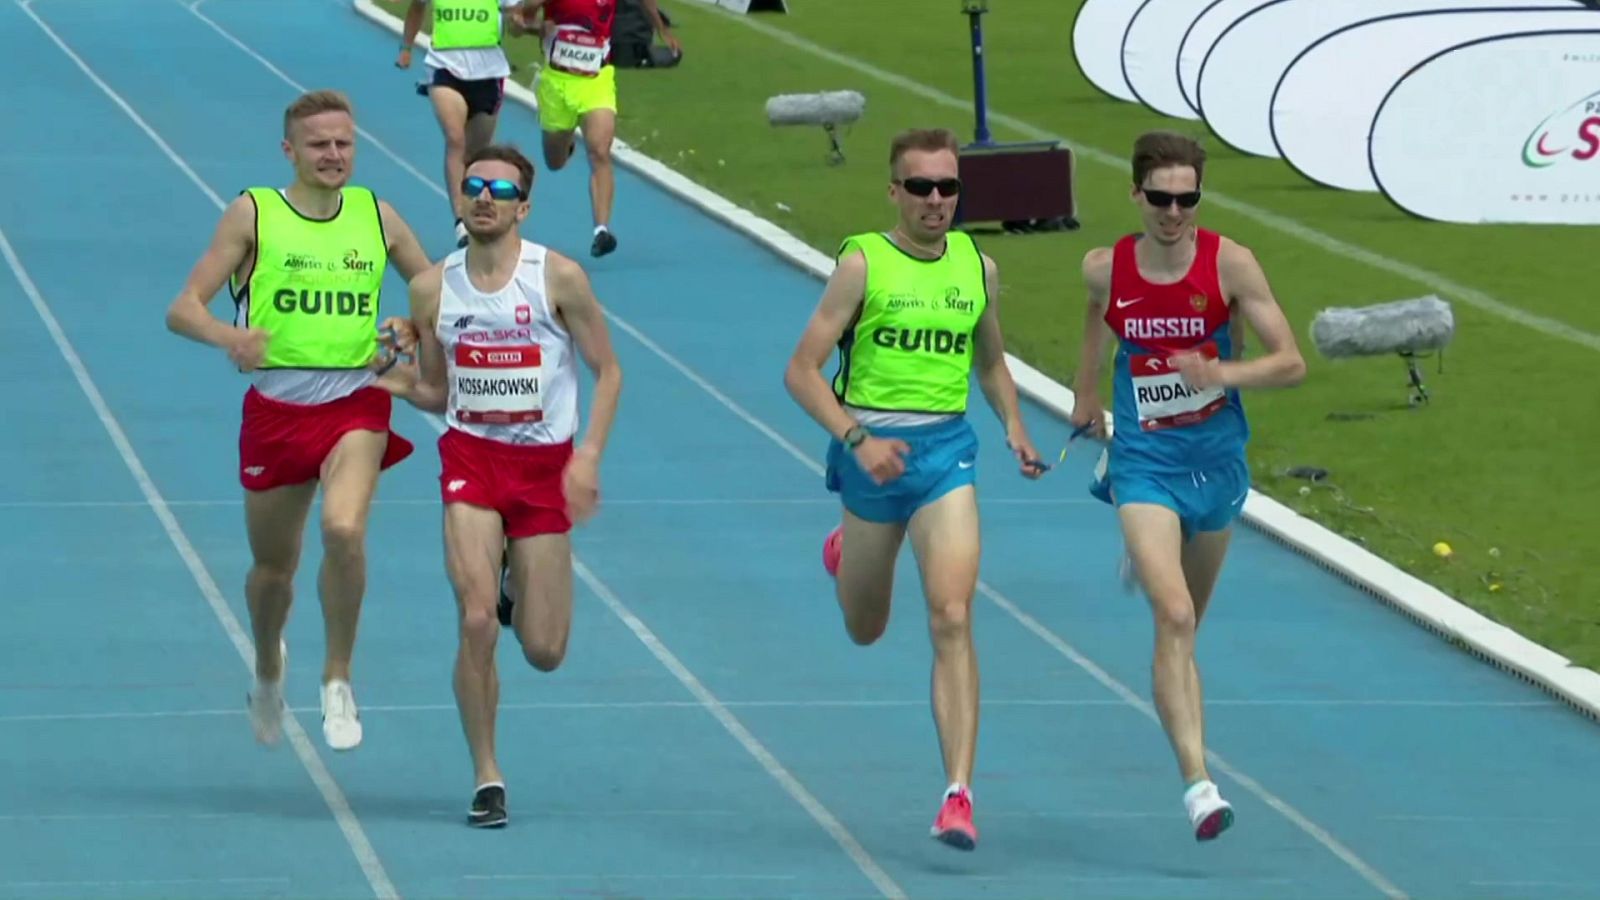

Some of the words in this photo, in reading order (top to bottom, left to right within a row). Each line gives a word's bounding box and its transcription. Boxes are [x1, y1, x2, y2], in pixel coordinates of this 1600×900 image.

[342, 256, 374, 272] Start
[273, 288, 372, 316] GUIDE
[944, 296, 974, 313] Start
[458, 327, 531, 344] POLSKA
[1124, 317, 1205, 339] RUSSIA
[872, 326, 967, 355] GUIDE
[458, 376, 538, 397] KOSSAKOWSKI
[1137, 382, 1200, 404] RUDAK
